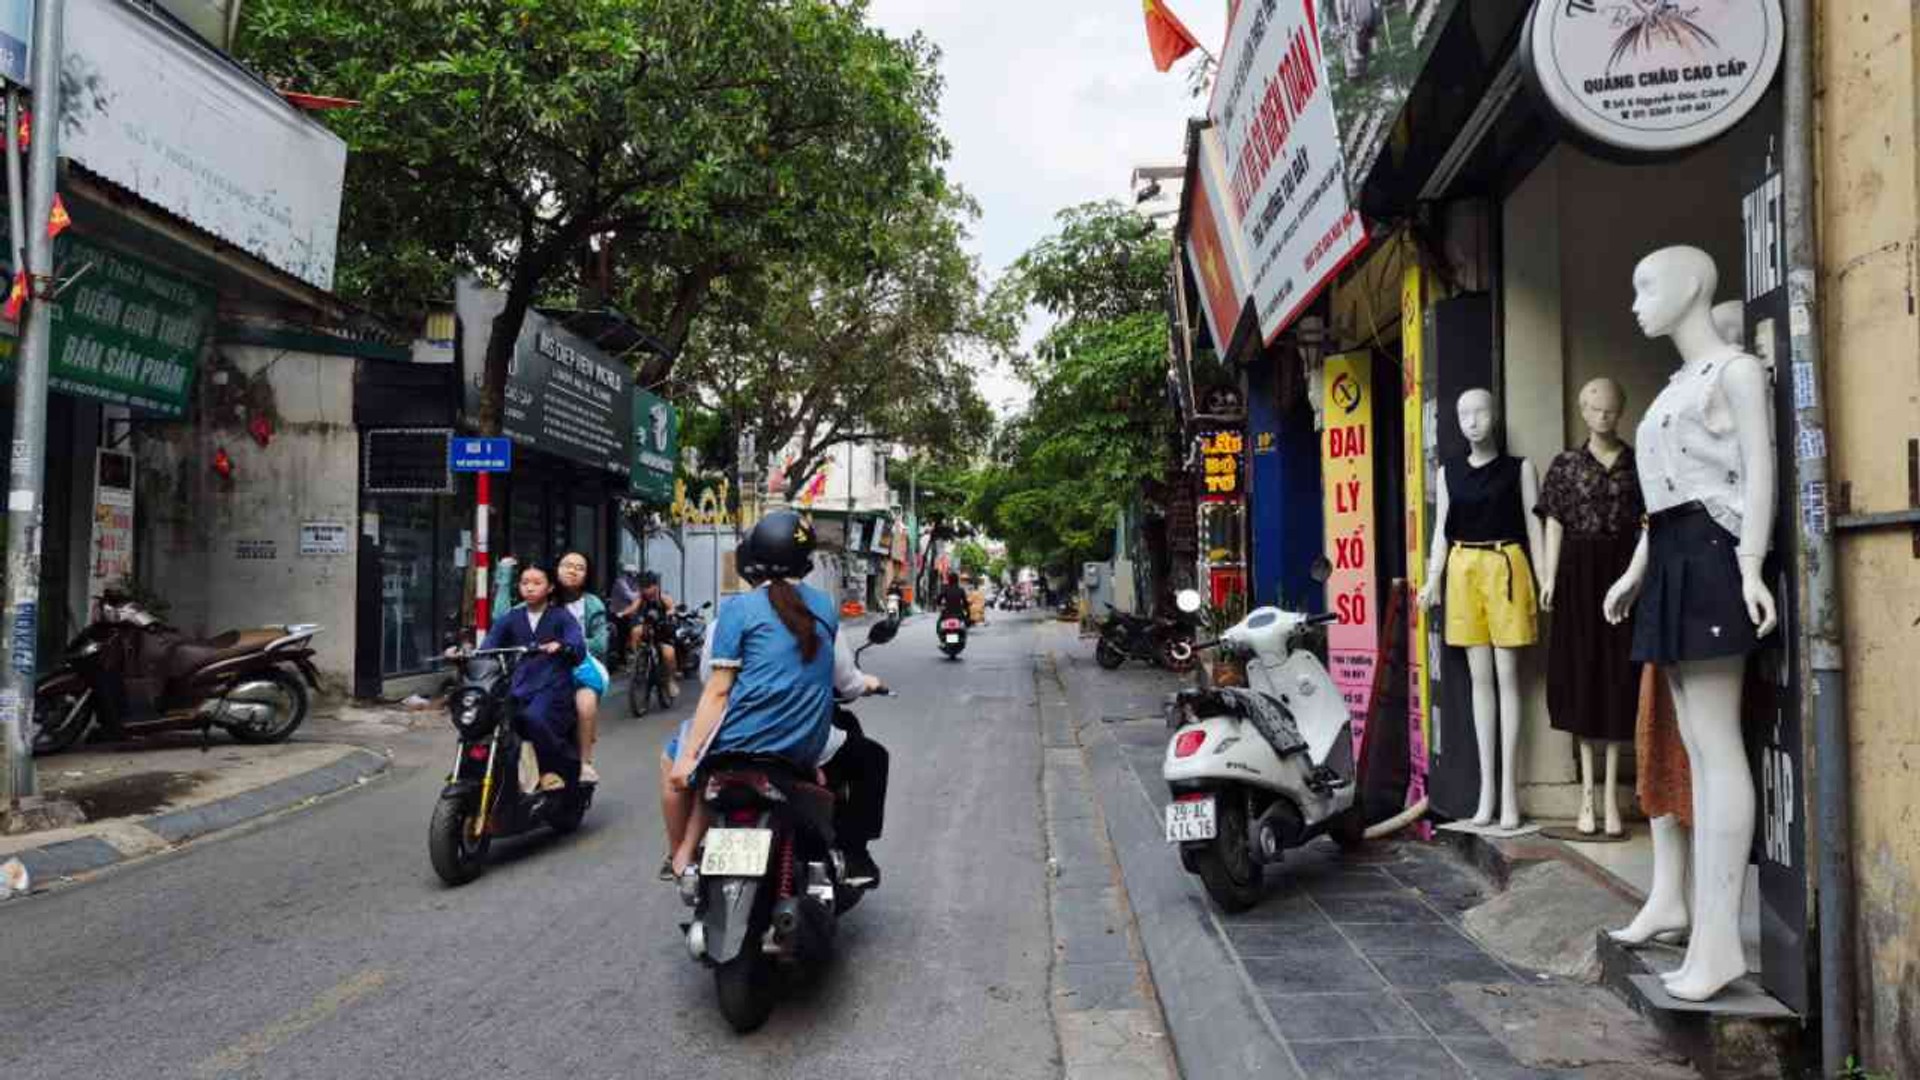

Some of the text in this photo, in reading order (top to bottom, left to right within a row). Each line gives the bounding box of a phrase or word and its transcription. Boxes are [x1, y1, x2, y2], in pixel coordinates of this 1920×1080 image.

[1638, 67, 1678, 87] CHÂU
[1682, 65, 1713, 81] CAO
[1716, 57, 1747, 77] CẤP
[1329, 424, 1366, 463] ĐẠI
[1335, 473, 1361, 514] LÝ
[1336, 582, 1366, 625] SỐ
